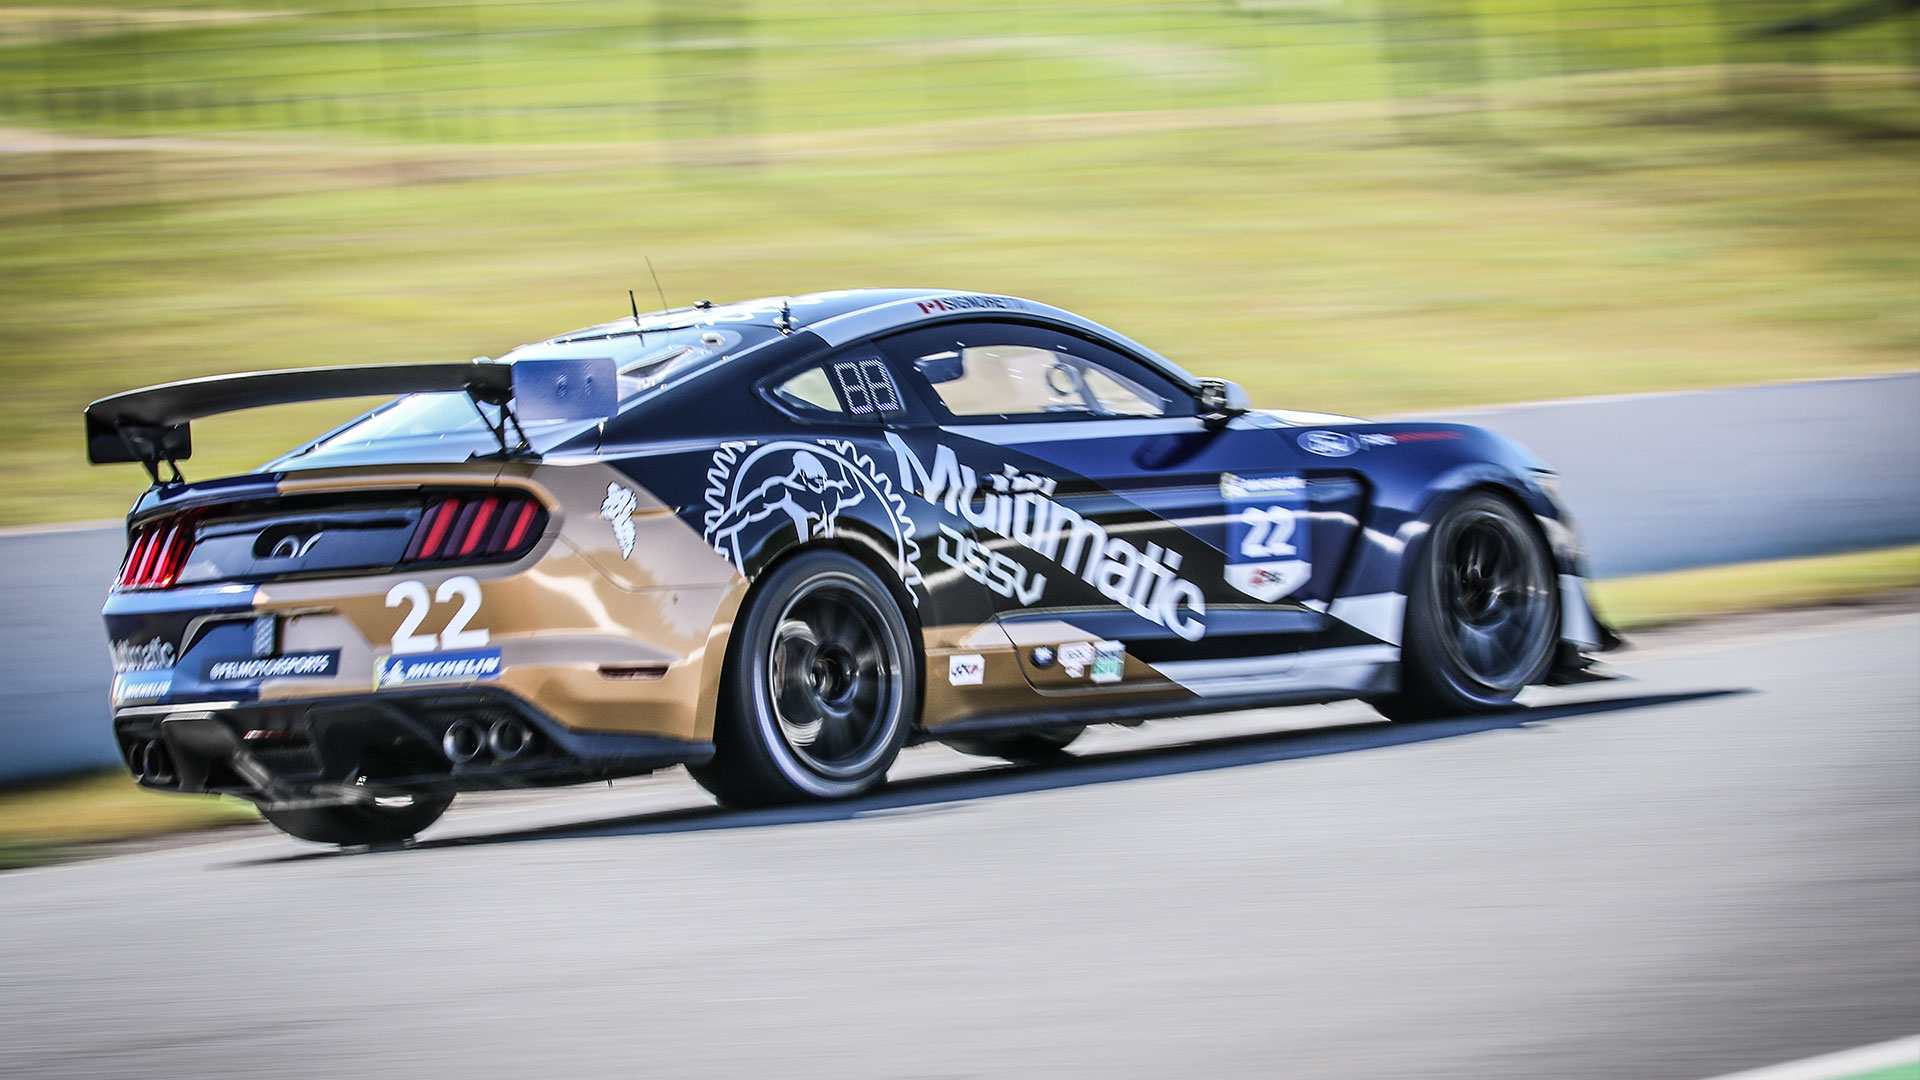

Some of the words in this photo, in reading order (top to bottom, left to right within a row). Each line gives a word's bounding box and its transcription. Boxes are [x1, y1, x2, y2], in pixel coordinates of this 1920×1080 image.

[884, 430, 1206, 642] Multimatic
[1241, 505, 1296, 558] 22
[385, 576, 490, 655] 22
[404, 656, 501, 679] MICHELIN
